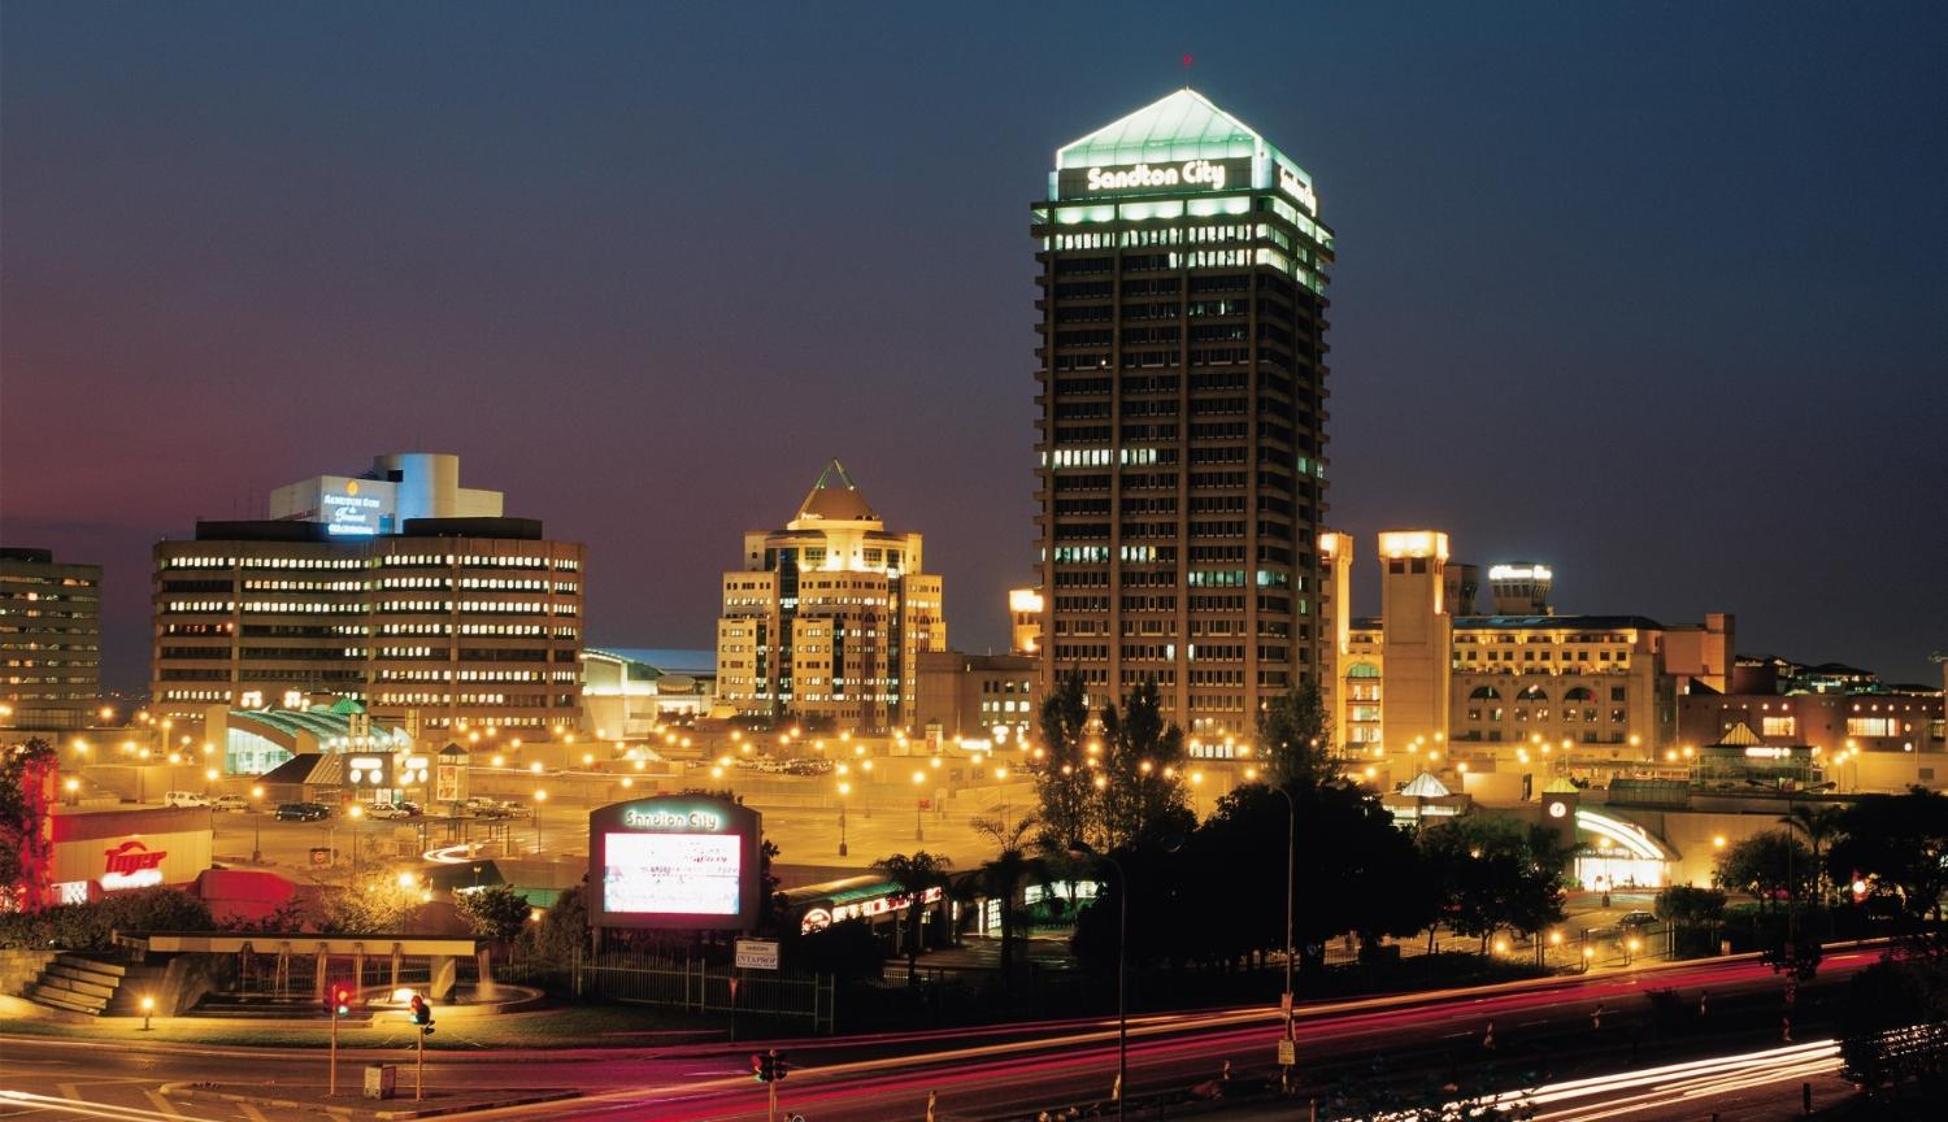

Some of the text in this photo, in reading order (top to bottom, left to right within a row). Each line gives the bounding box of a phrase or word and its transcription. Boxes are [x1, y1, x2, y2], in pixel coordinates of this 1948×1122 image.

[1087, 160, 1225, 190] Sandton City
[625, 811, 719, 829] Sandton City
